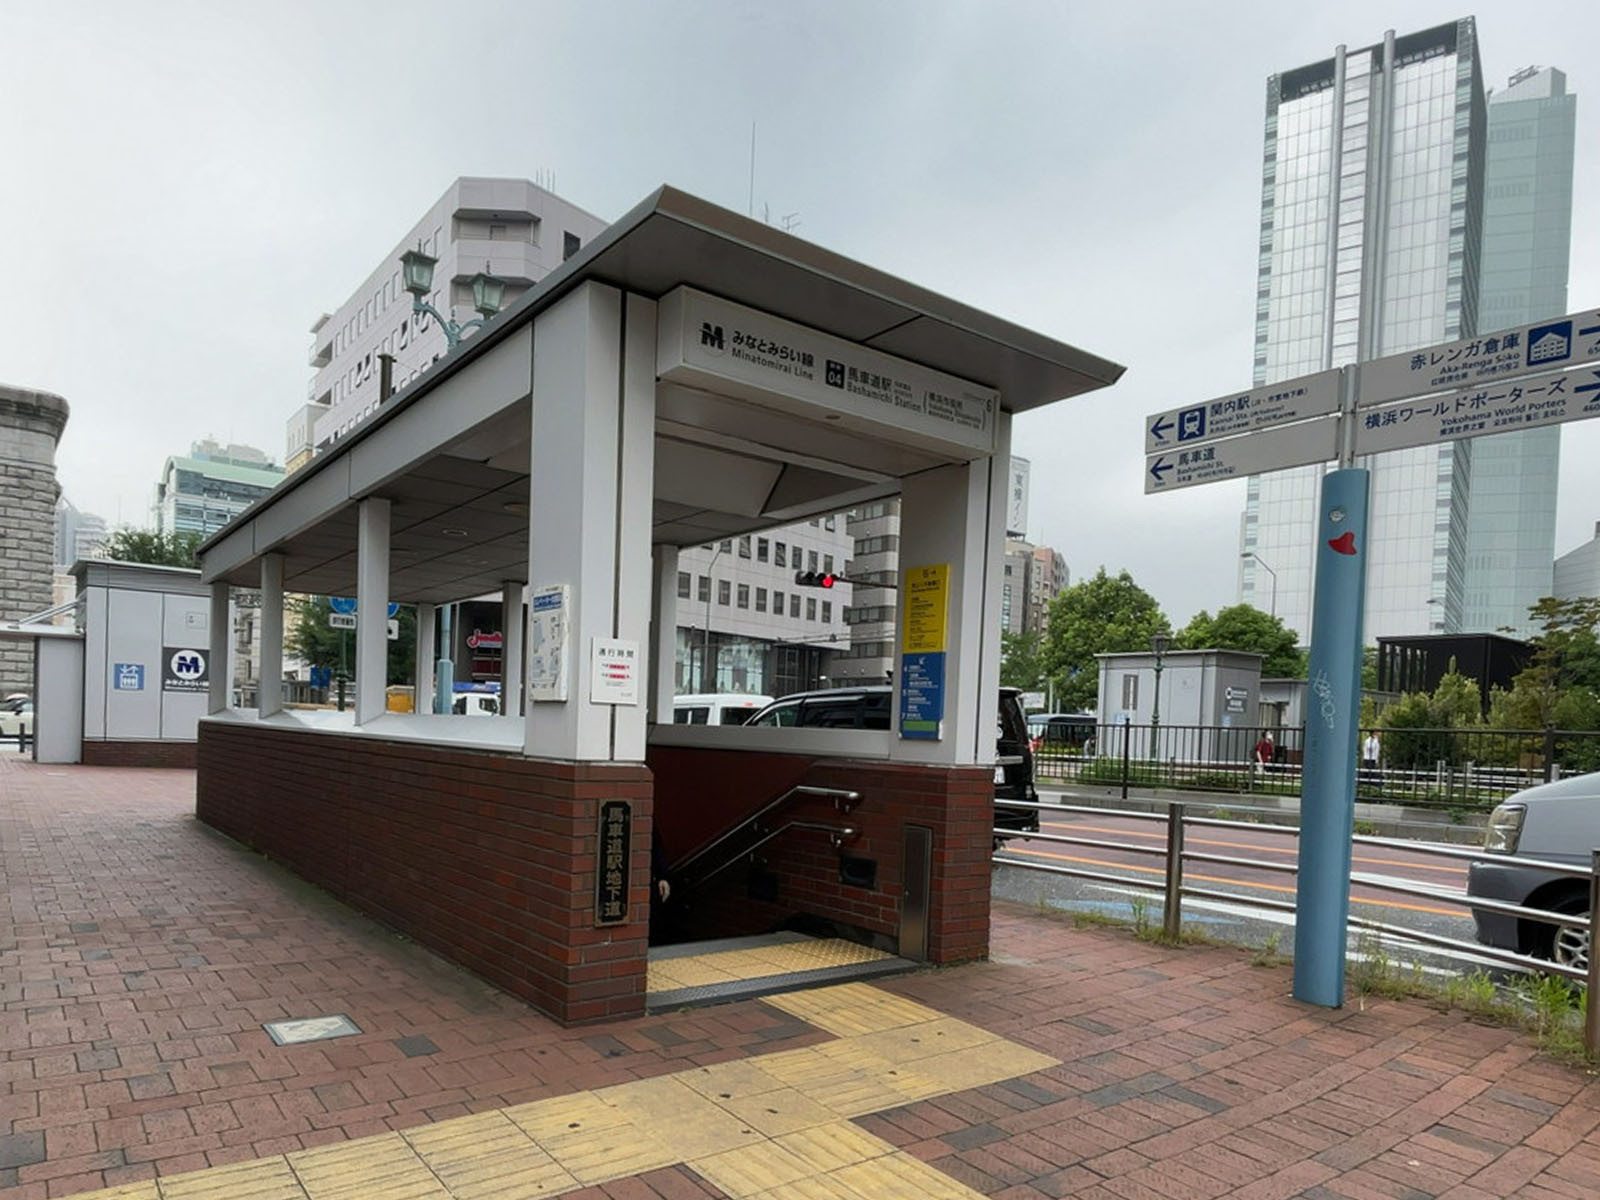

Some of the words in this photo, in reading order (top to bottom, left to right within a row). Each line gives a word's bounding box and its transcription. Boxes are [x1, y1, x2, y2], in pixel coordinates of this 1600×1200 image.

[732, 330, 814, 367] みなとみらい線
[1410, 332, 1521, 372] 赤レンガ倉庫
[731, 347, 791, 375] Minatomirai
[794, 366, 813, 381] Line
[828, 370, 842, 386] 04
[1440, 360, 1493, 376] Aka-Renga
[848, 366, 893, 392] 馬車道駅
[846, 381, 893, 404] Bashamichi
[894, 395, 922, 413] Station
[1210, 395, 1250, 418] 関内駅
[1365, 377, 1568, 430] 横浜ワールドポーターズ
[1441, 409, 1492, 426] Yokohama
[1495, 403, 1526, 418] World
[1528, 399, 1567, 412] Porters
[1178, 447, 1215, 467] 馬車道
[605, 807, 624, 917] 馬車道駅地下道
